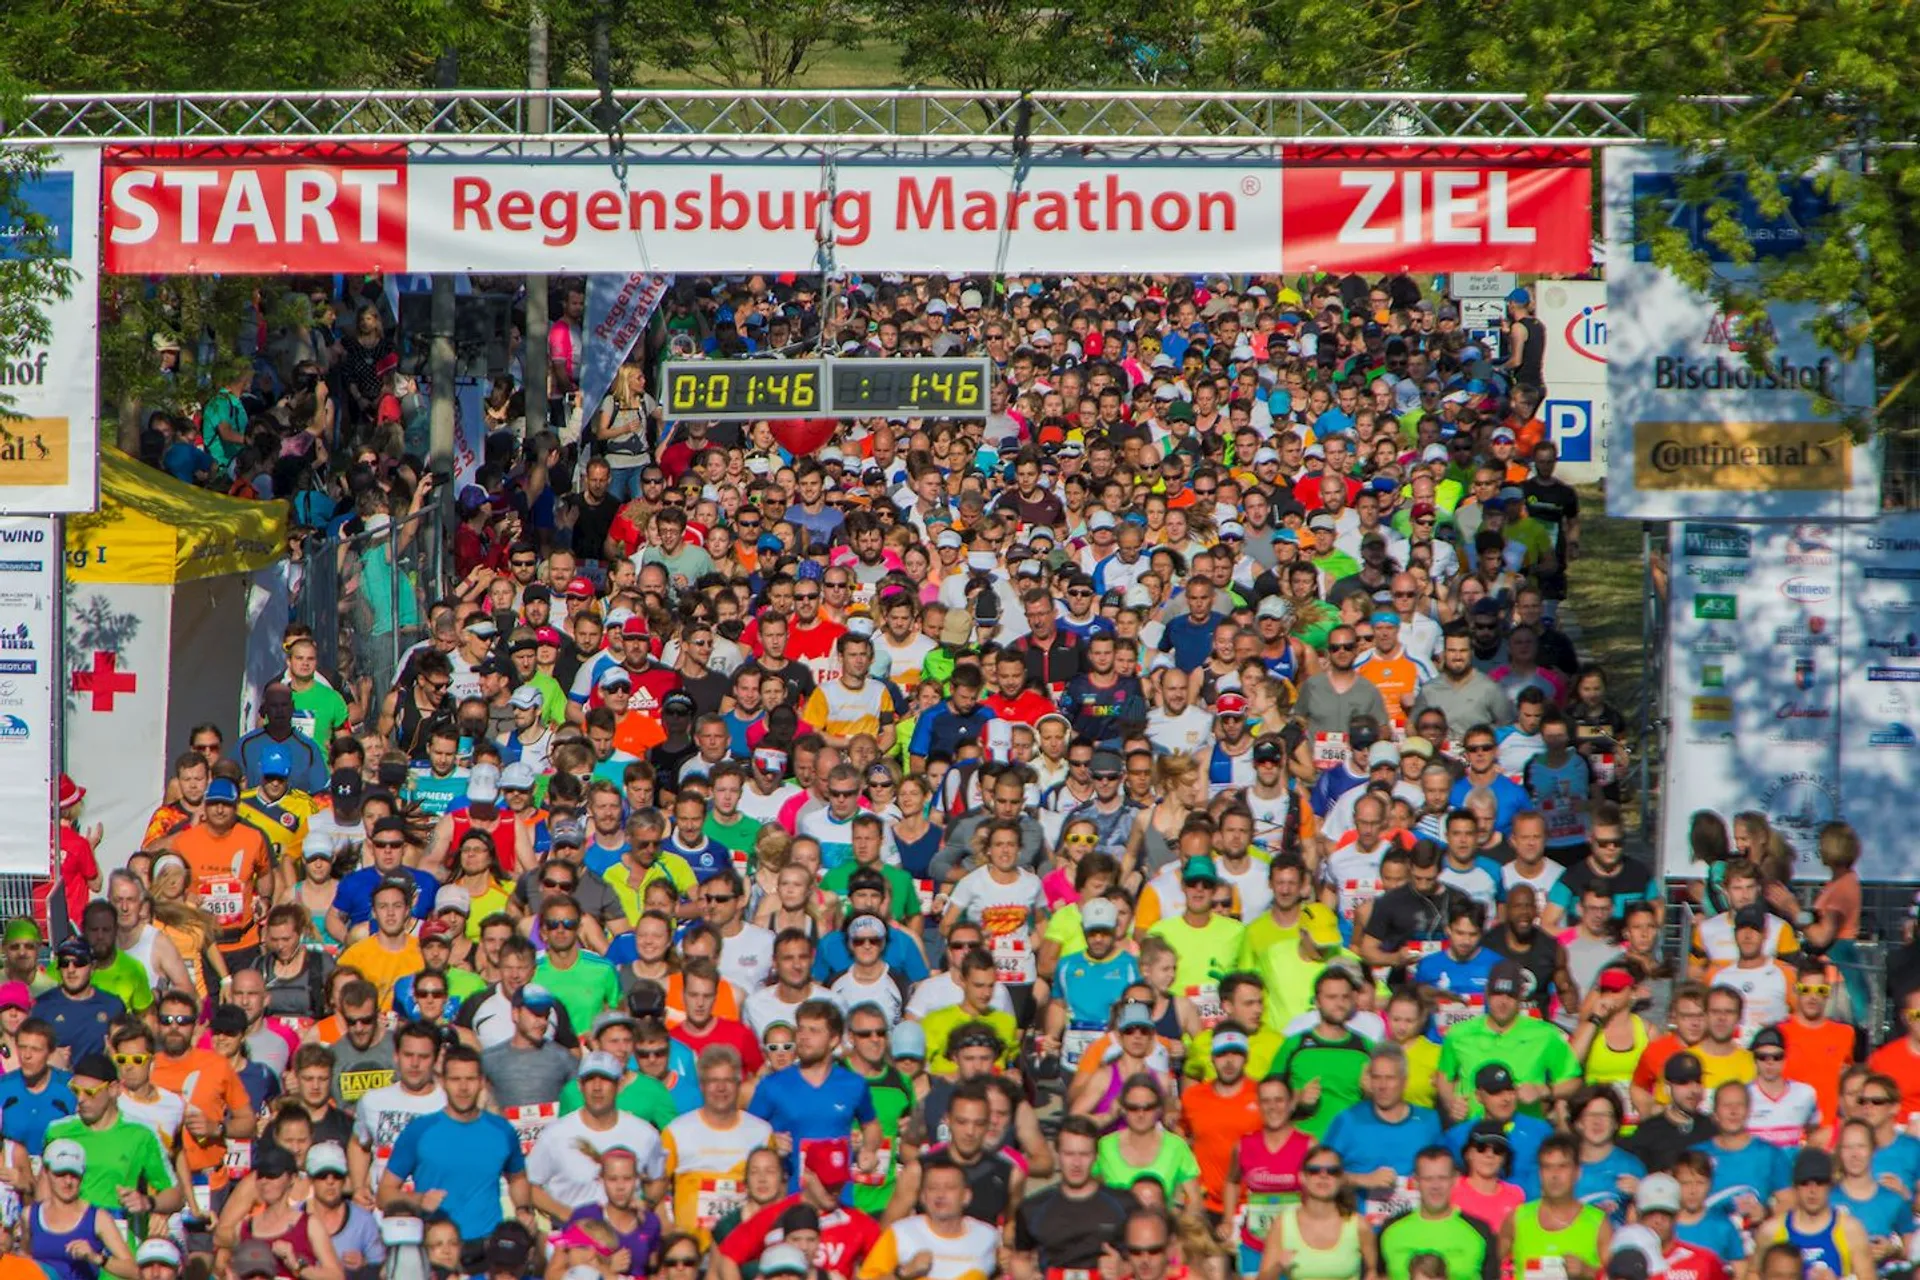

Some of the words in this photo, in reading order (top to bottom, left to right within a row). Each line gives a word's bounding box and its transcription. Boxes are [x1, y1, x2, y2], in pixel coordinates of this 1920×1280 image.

[109, 169, 399, 246] START
[452, 173, 872, 247] Regensburg
[1339, 170, 1537, 245] ZIEL
[596, 271, 644, 340] Regens
[612, 273, 667, 350] Maratho
[1551, 404, 1588, 458] P
[1652, 440, 1809, 473] Continental
[341, 1073, 395, 1090] HAVOK
